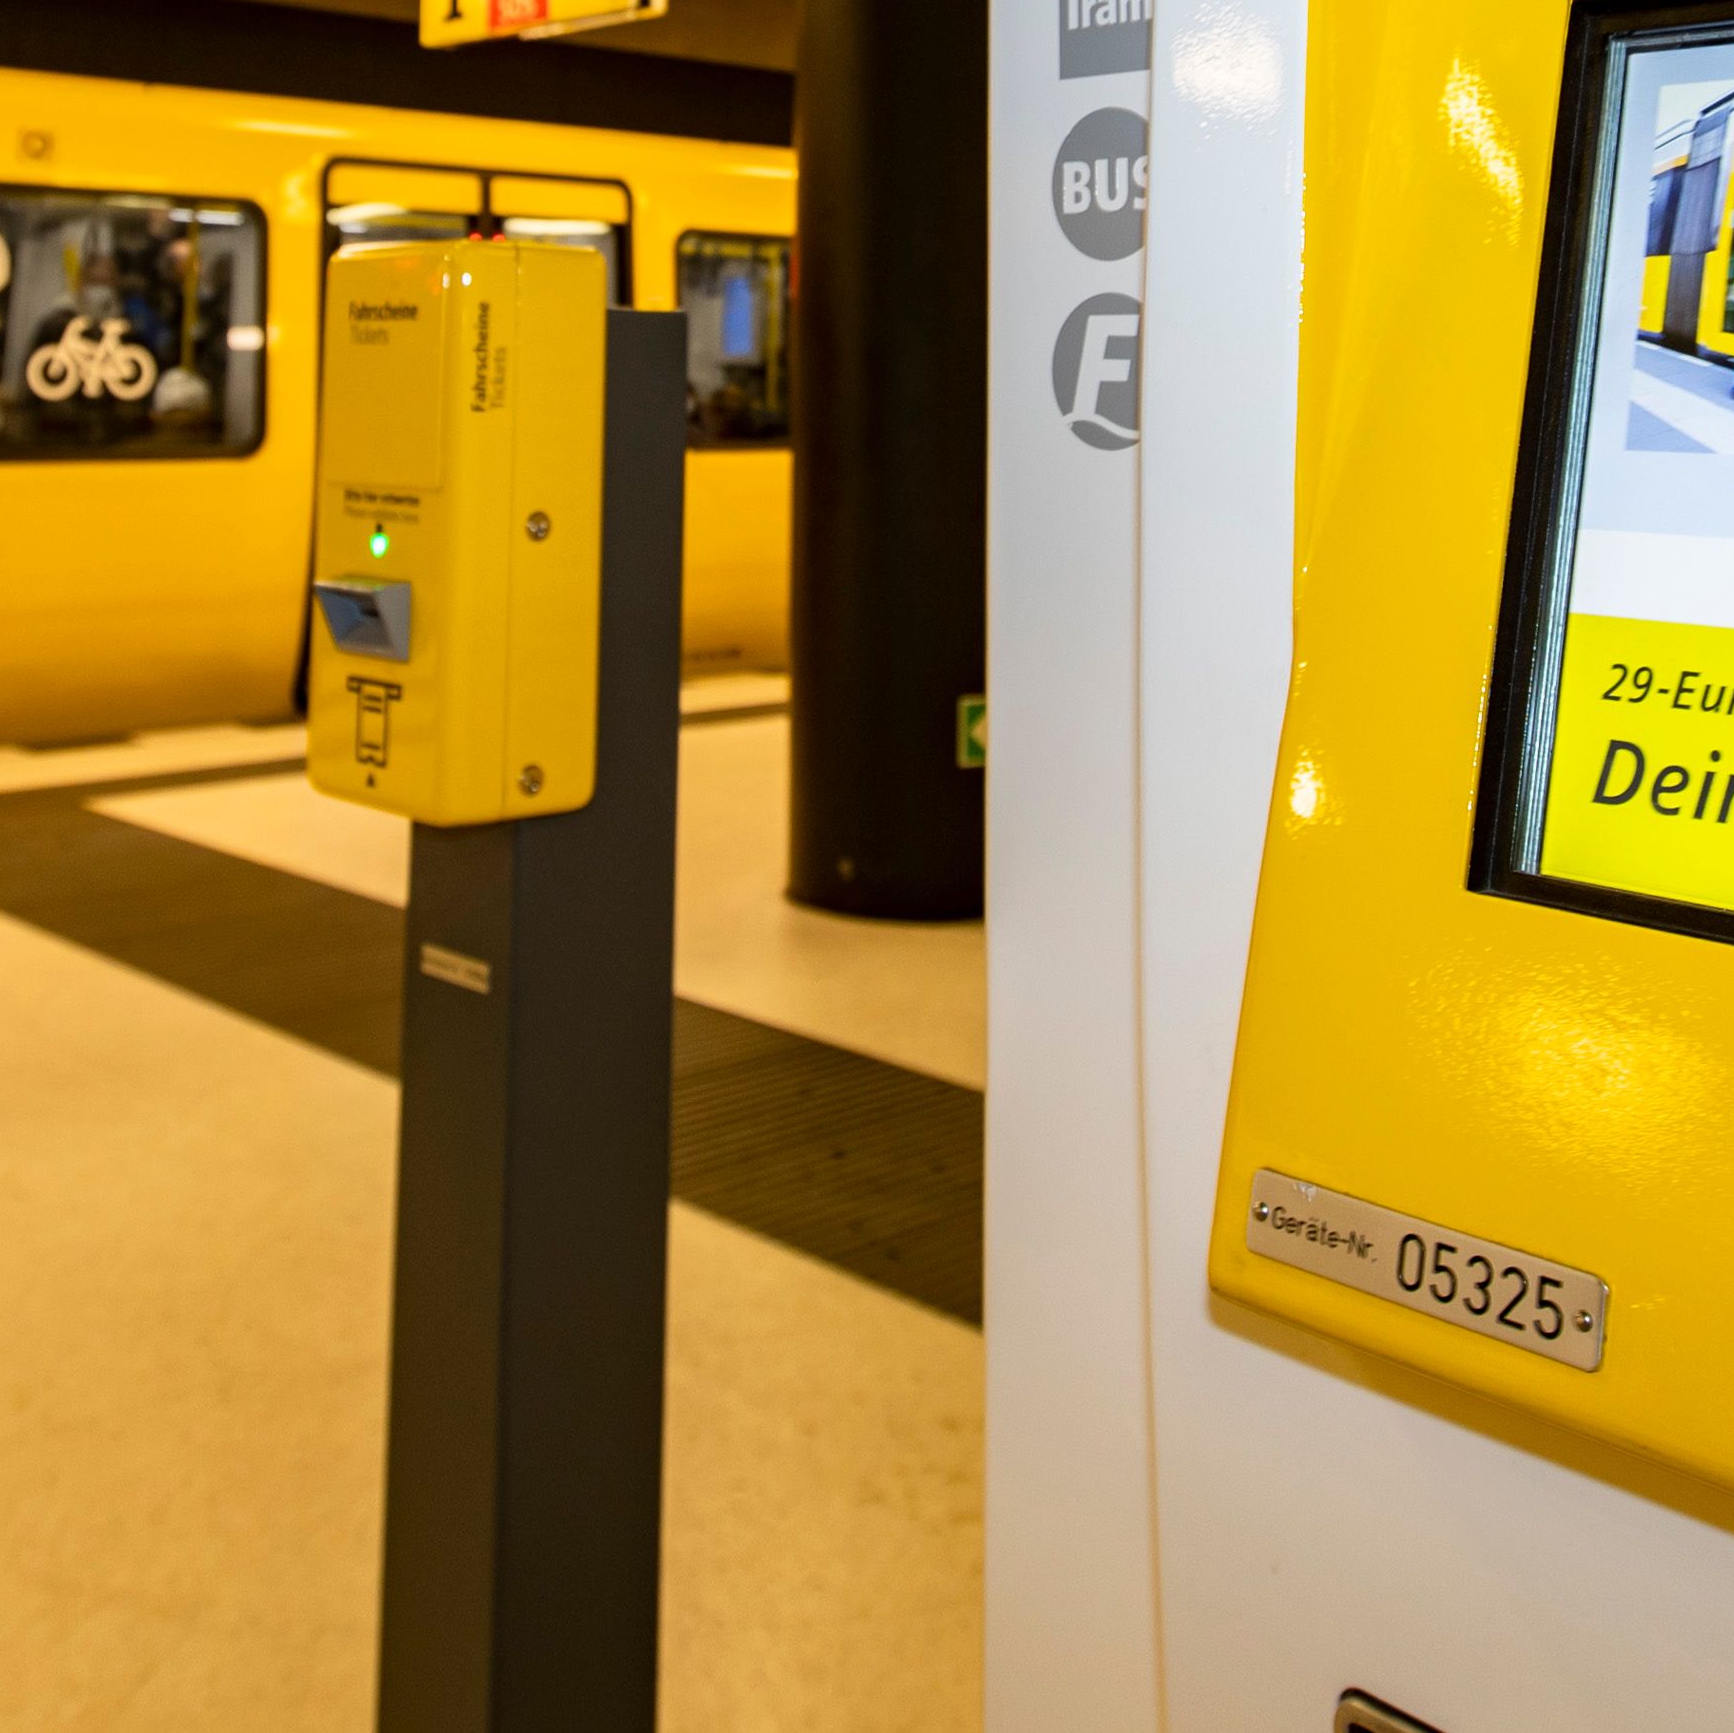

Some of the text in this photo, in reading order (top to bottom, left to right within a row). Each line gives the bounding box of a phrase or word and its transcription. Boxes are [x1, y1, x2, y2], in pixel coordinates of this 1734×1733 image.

[471, 302, 490, 412] Fahrscheine
[1271, 1205, 1565, 1340] Geräte-Nr. 05325
